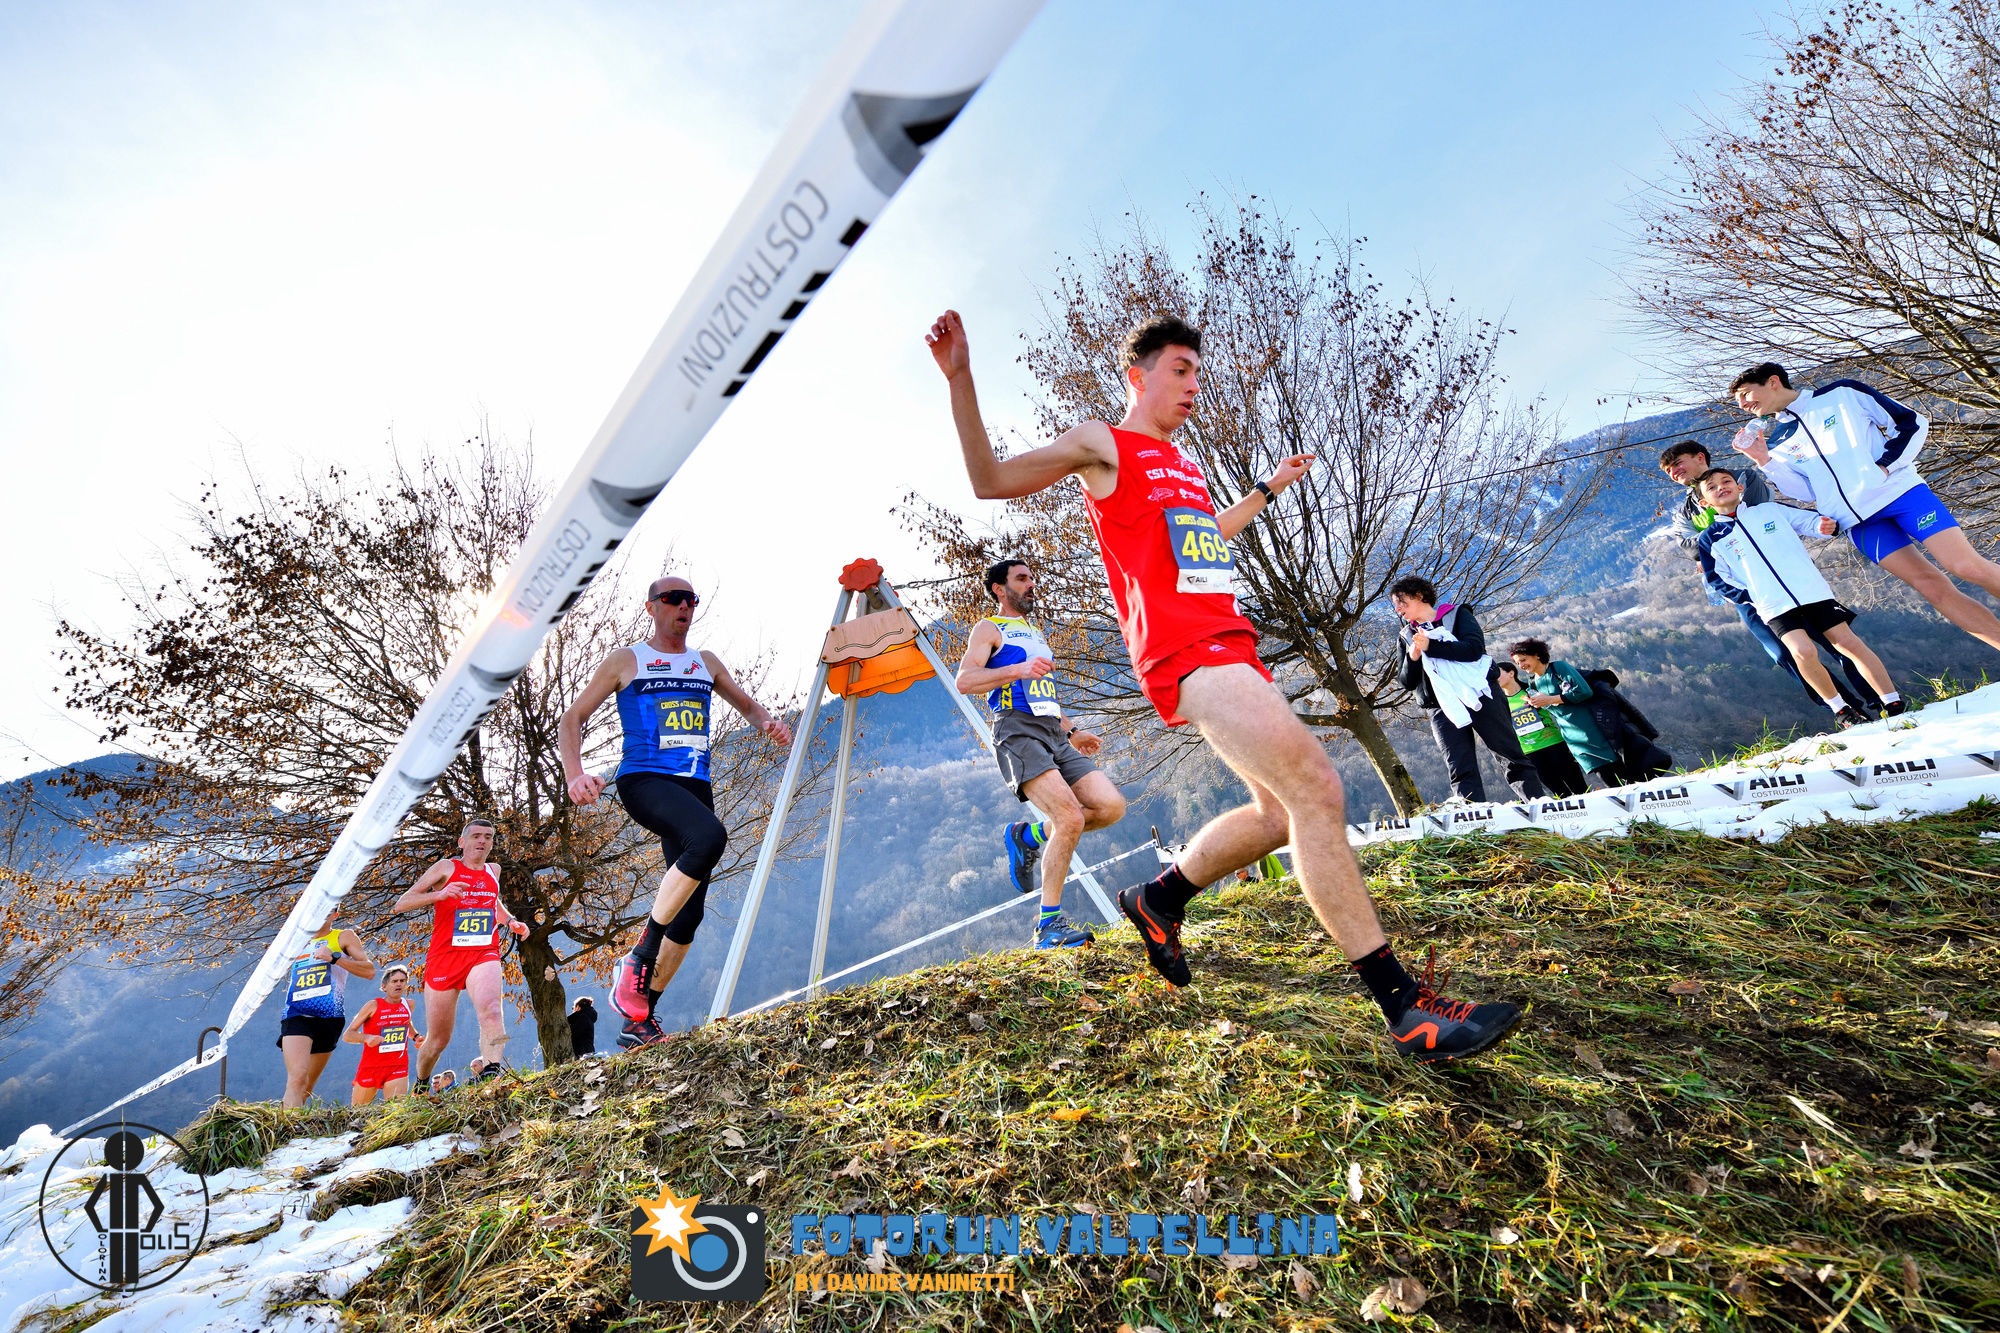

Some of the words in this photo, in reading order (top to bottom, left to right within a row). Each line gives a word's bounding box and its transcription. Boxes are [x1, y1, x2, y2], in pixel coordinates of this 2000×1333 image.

[677, 179, 830, 389] COSTRUZIONI
[1145, 468, 1166, 480] CSI
[1182, 530, 1231, 563] 469
[641, 681, 680, 692] A.D.M.
[682, 682, 712, 692] PONTE
[1029, 679, 1057, 700] 409
[665, 709, 704, 731] 404
[1513, 712, 1537, 727] 368
[1873, 758, 1937, 776] AILI
[1749, 773, 1806, 790] AILI
[1875, 772, 1940, 785] COSTRUZIONI
[1639, 787, 1690, 803] AILI
[1751, 787, 1808, 799] COSTRUZIONI
[1541, 799, 1586, 814] AILI
[1641, 799, 1692, 811] COSTRUZIONI
[1453, 809, 1494, 823] AILI
[1543, 811, 1589, 822] COSTRUZIONI
[1375, 818, 1411, 832] AILI
[458, 918, 488, 933] 451
[296, 971, 327, 988] 487
[383, 1031, 404, 1043] 464
